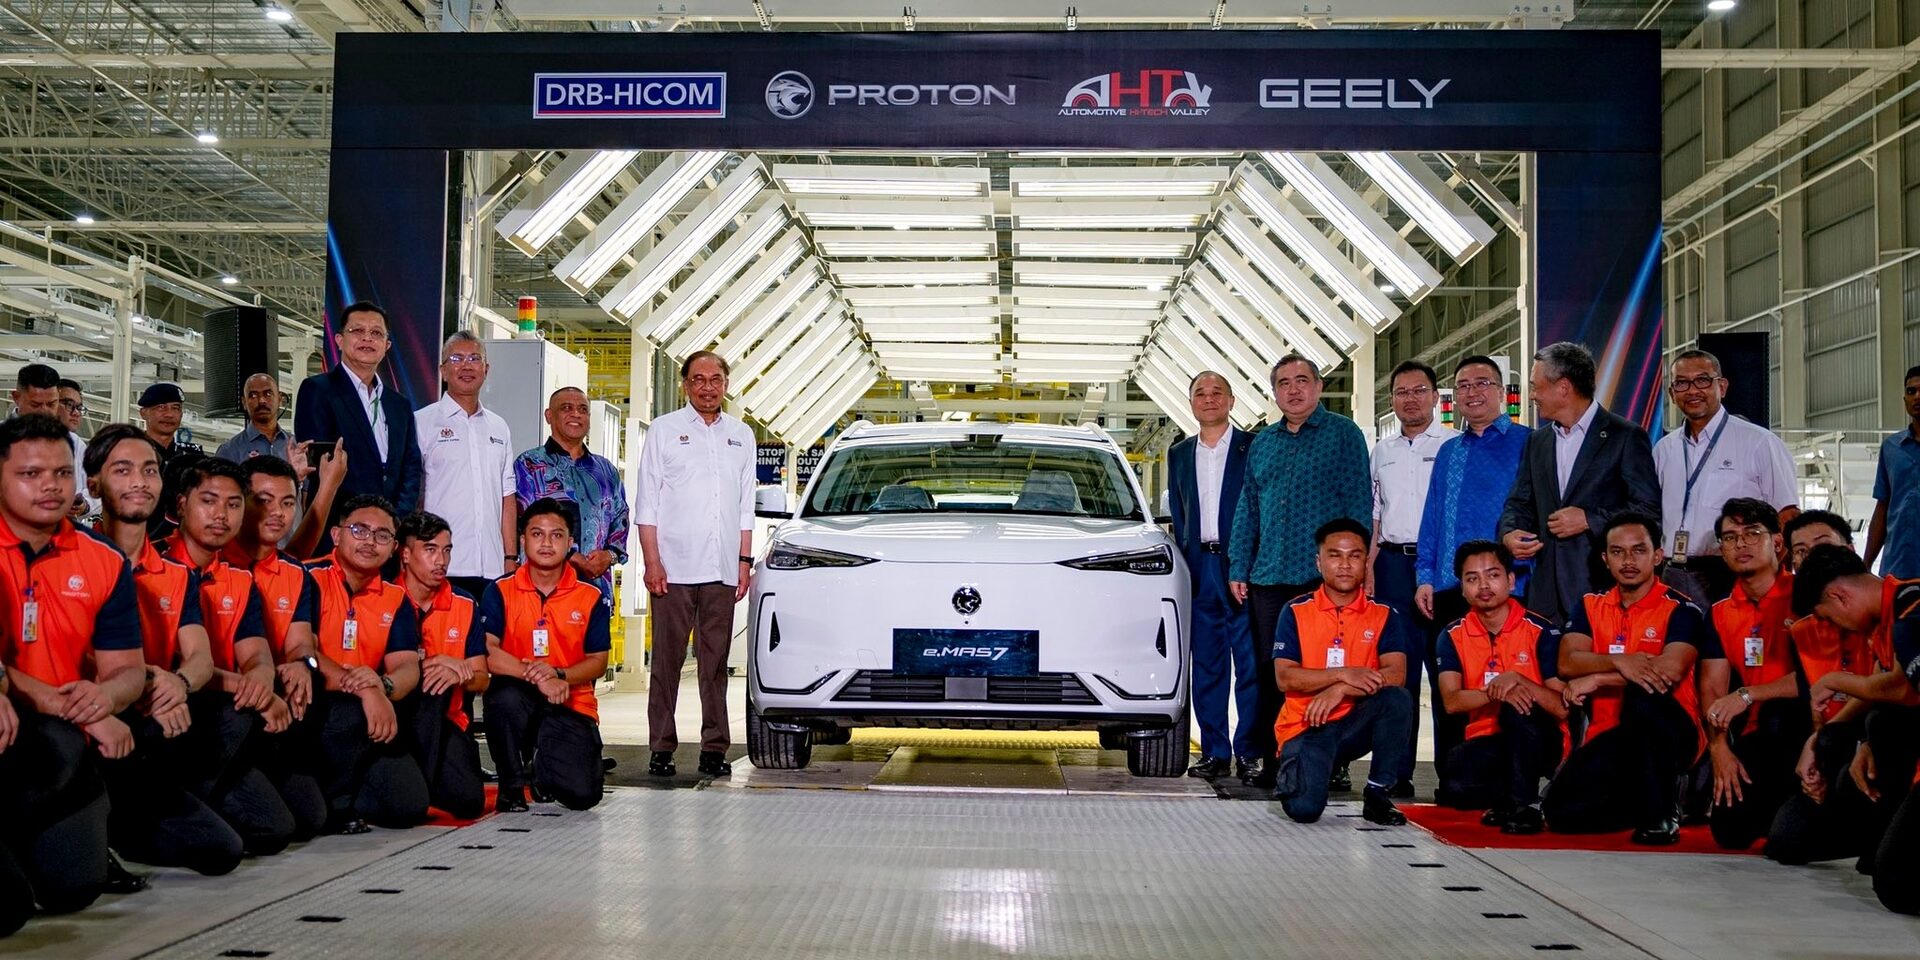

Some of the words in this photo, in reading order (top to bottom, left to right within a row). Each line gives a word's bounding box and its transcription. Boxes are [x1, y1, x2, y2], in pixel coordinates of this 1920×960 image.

[546, 82, 714, 106] DRB-HICOM
[828, 84, 1016, 106] PROTON
[1259, 79, 1452, 109] GEELY
[1058, 108, 1127, 116] AUTOMOTIVE
[1170, 108, 1211, 116] VALLEY
[758, 448, 784, 457] STOP
[756, 457, 780, 465] HINK
